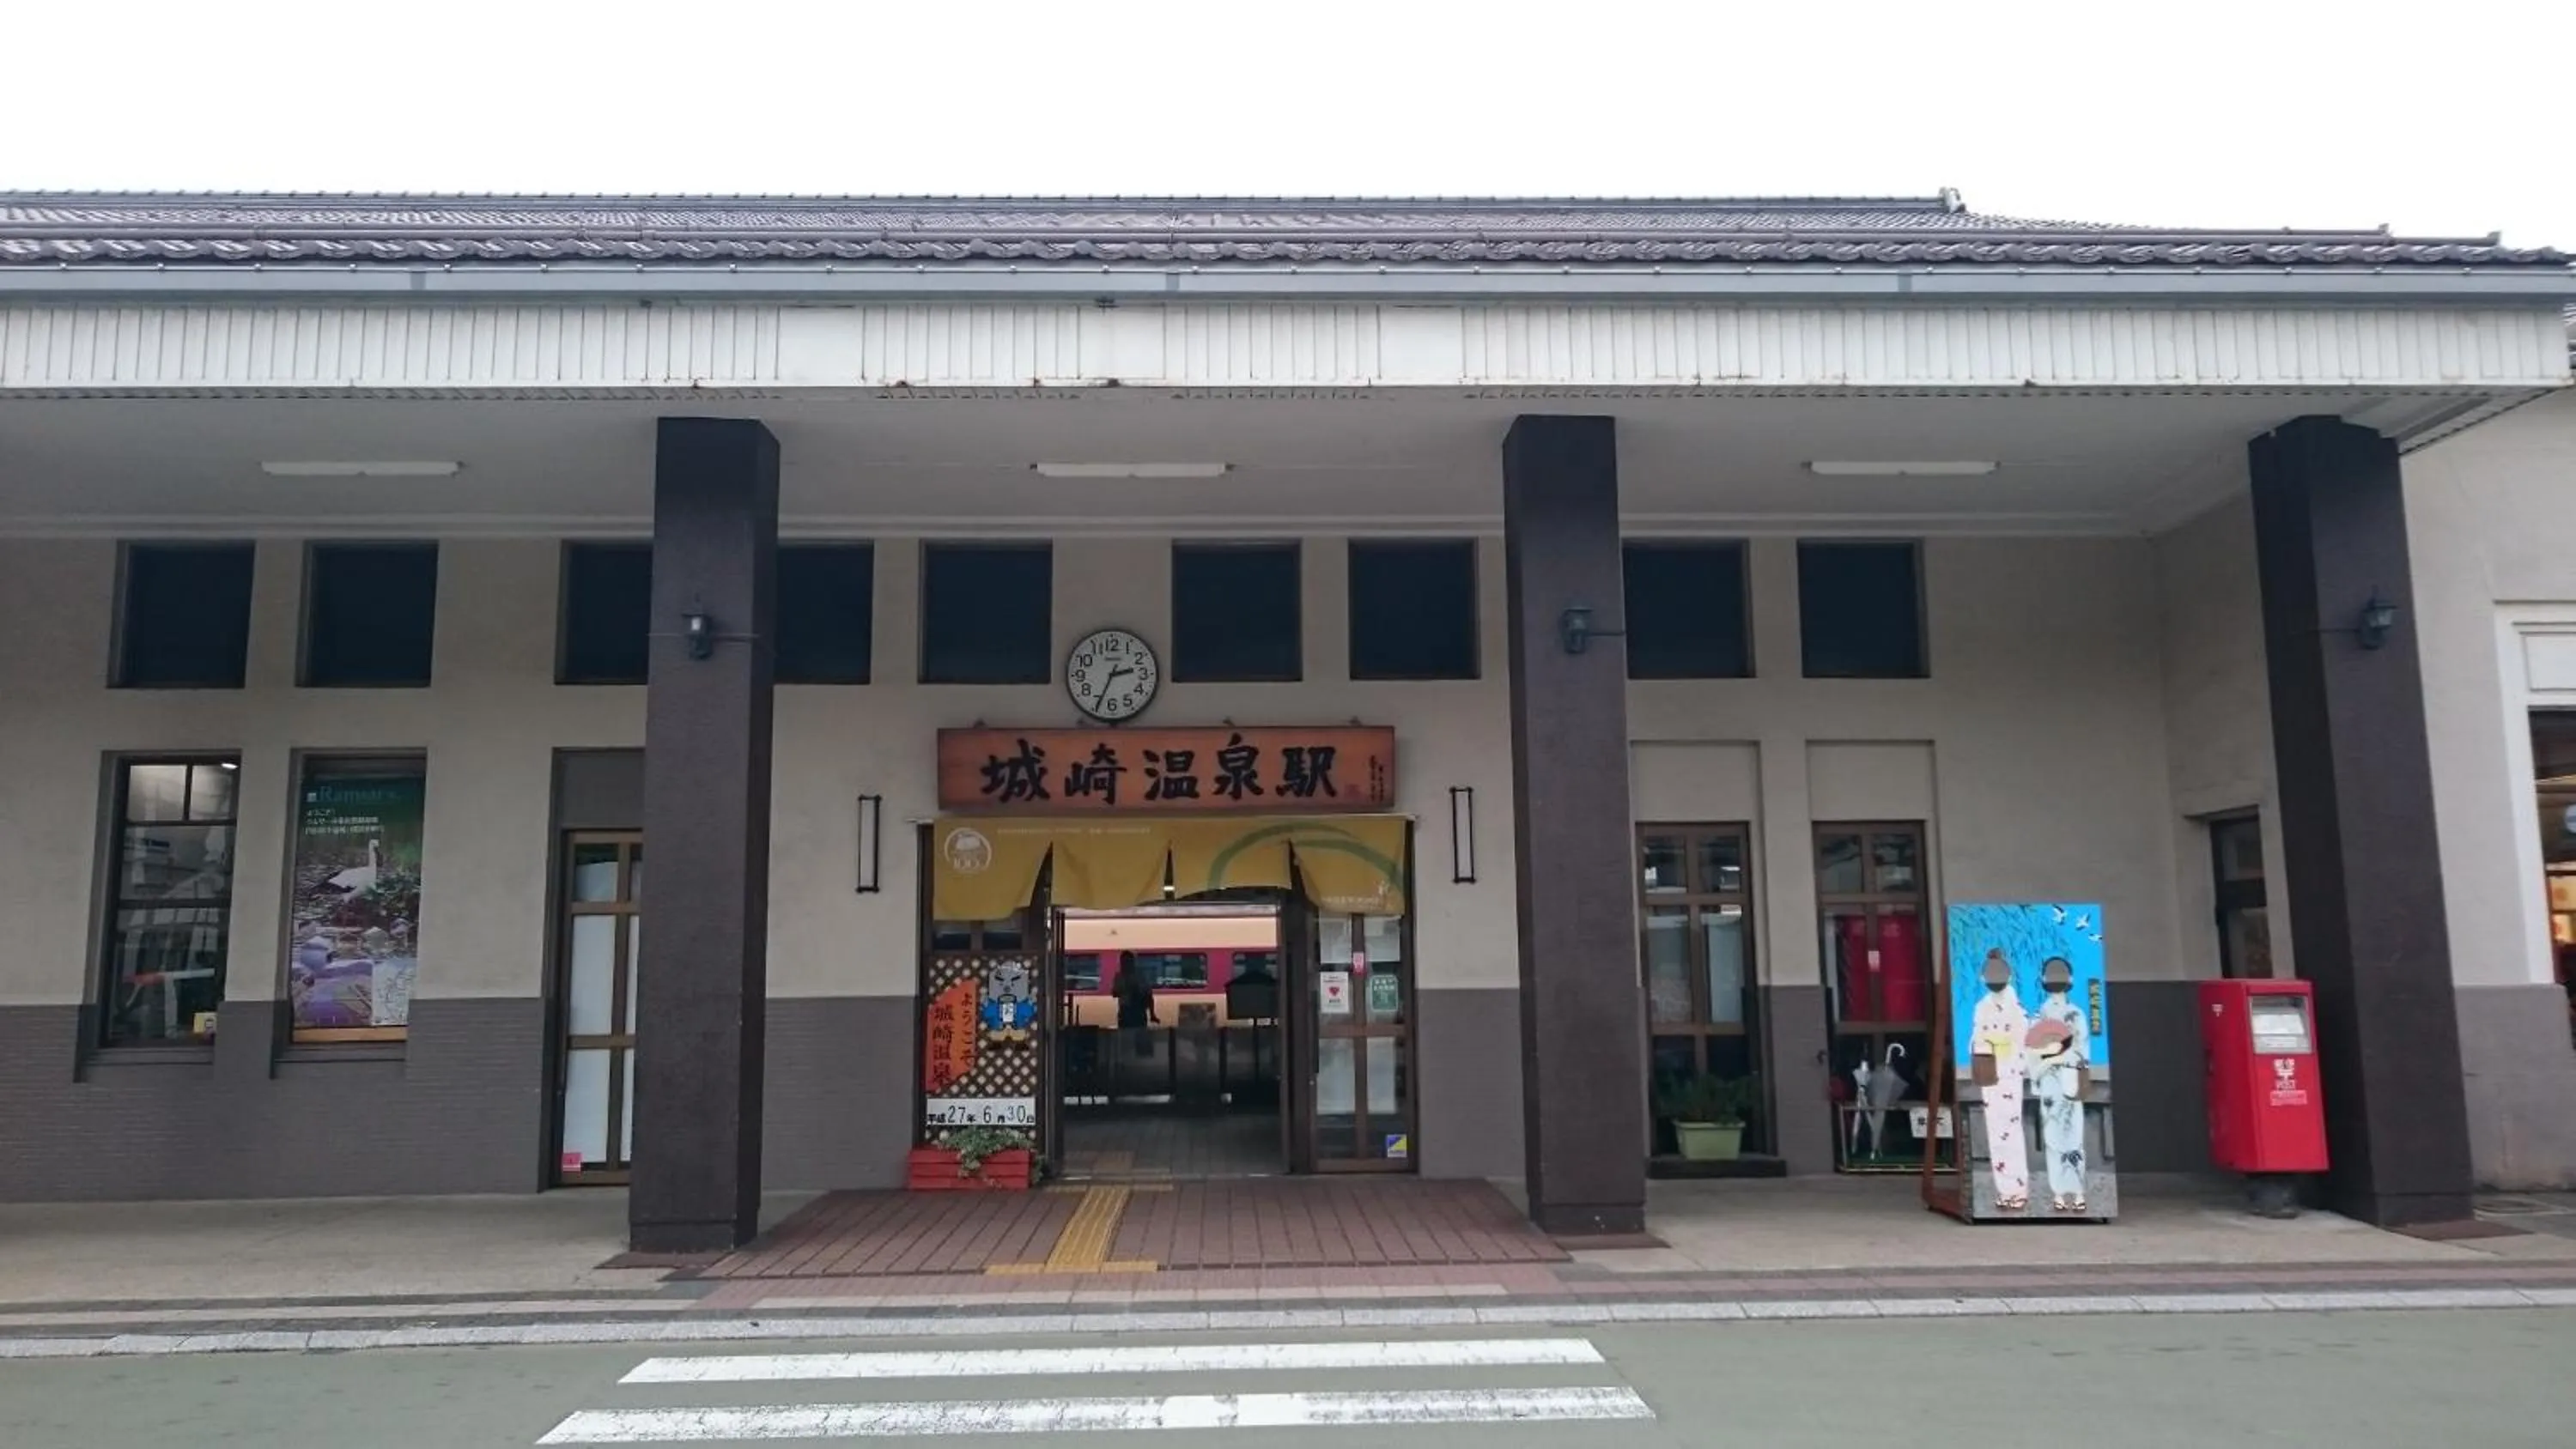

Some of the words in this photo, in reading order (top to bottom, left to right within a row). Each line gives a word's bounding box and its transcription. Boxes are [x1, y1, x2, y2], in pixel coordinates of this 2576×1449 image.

[1105, 638, 1119, 652] 12
[1126, 641, 1130, 654] 1
[1075, 653, 1093, 668] 10
[1134, 652, 1145, 665] 2
[1074, 669, 1086, 682] 9
[1139, 667, 1149, 681] 3
[1081, 682, 1091, 696] 8
[1133, 682, 1145, 696] 4
[1107, 698, 1117, 712] 6
[1122, 693, 1133, 707] 5
[980, 733, 1339, 804] 城崎温泉駅
[960, 992, 975, 1067] ようこそ
[933, 1003, 954, 1085] 城崎温泉
